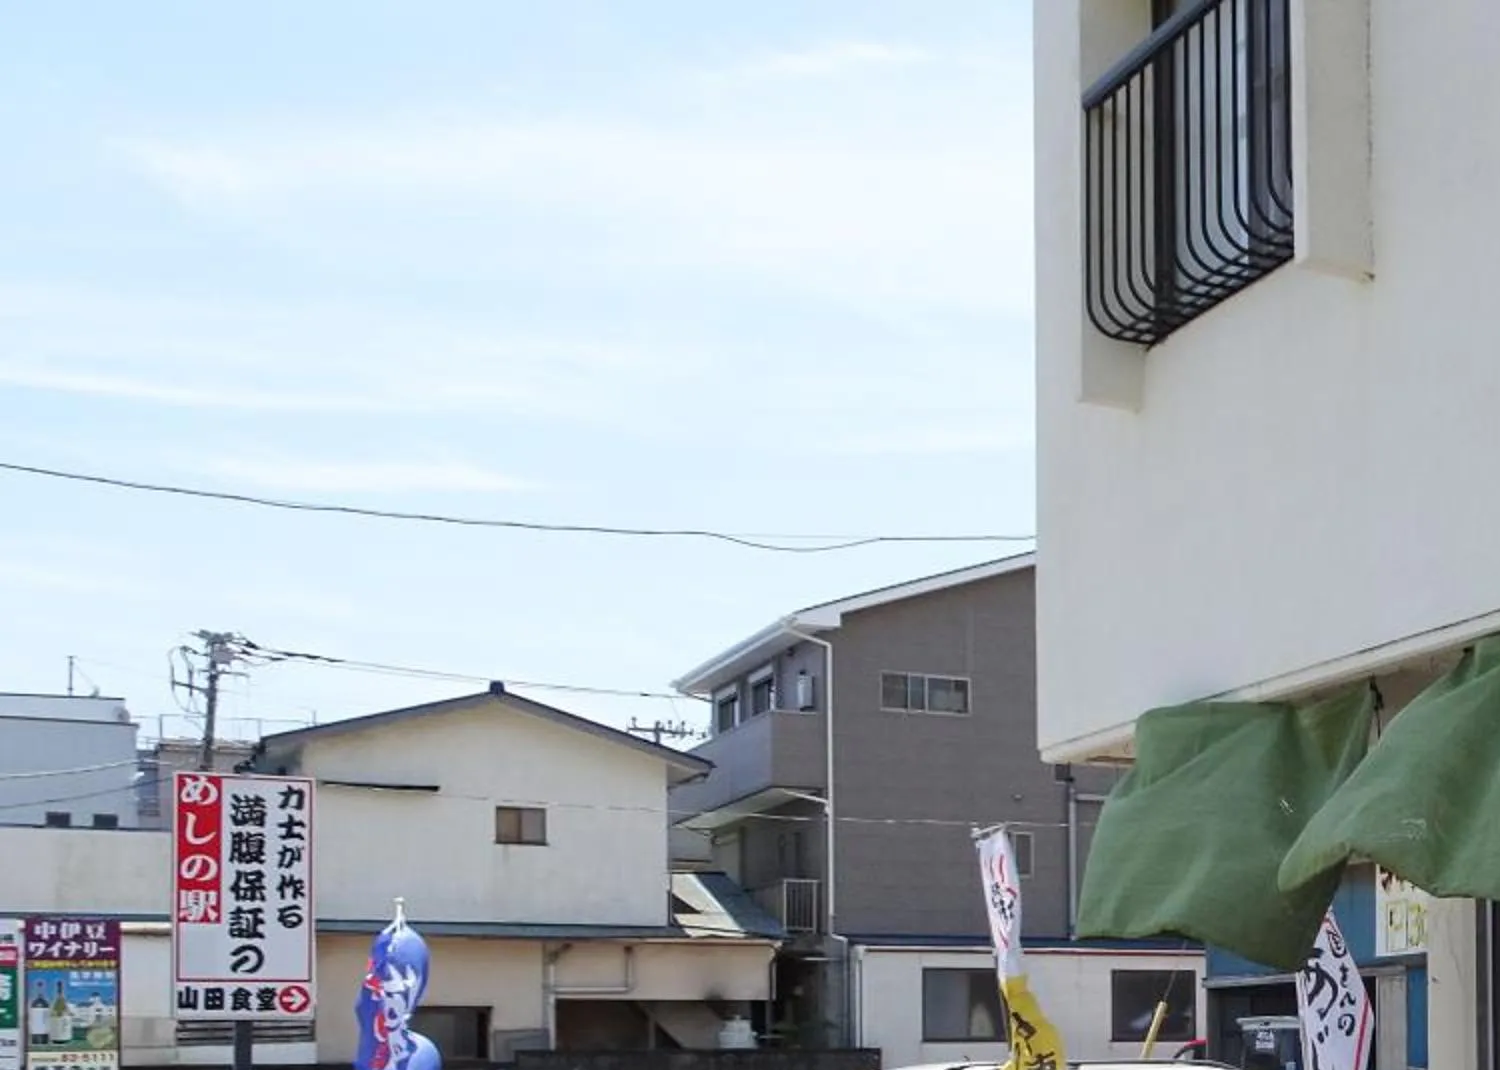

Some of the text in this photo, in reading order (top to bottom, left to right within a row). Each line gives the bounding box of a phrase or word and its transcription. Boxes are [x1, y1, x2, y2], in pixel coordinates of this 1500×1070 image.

[179, 775, 219, 923] めしの駅
[229, 793, 266, 974] 満腹保証の
[277, 785, 306, 929] 力士が作る
[28, 941, 115, 957] ワイナリー
[33, 921, 106, 939] 中伊豆
[177, 986, 277, 1011] 山田食堂
